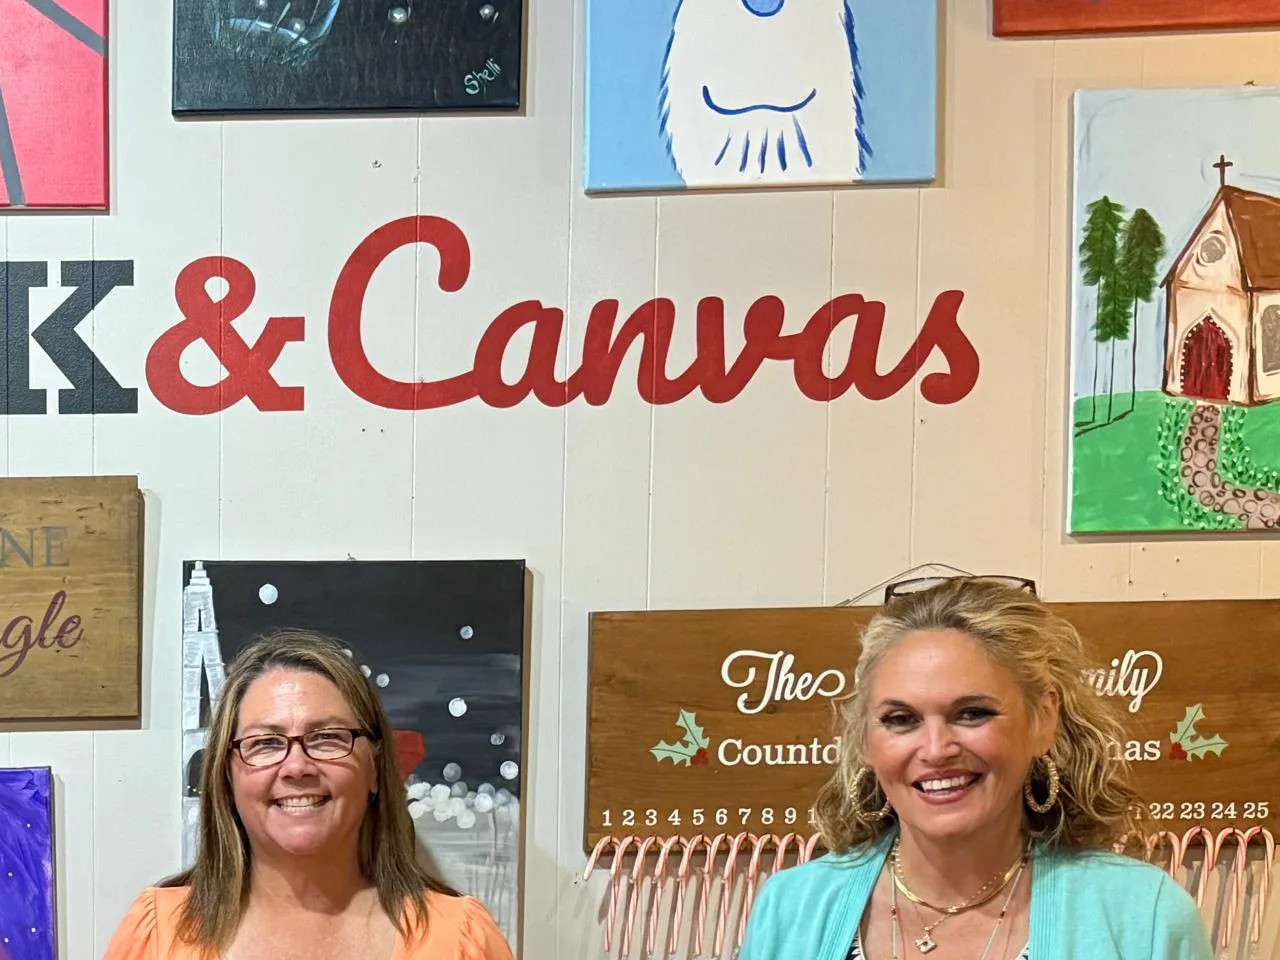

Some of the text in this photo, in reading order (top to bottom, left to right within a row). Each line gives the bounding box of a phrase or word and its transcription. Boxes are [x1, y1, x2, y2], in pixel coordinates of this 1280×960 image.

[463, 58, 502, 95] Shelli
[145, 255, 306, 416] &
[327, 214, 981, 411] Canvas
[721, 649, 846, 714] The
[602, 809, 612, 826] 1
[622, 809, 635, 826] 2
[645, 809, 658, 826] 3
[667, 808, 682, 826] 4
[692, 808, 705, 826] 5
[715, 808, 728, 825] 6
[738, 808, 752, 825] 7
[761, 807, 774, 825] 8
[784, 807, 797, 825] 9
[1149, 802, 1175, 819] 22
[1180, 802, 1206, 819] 23
[1211, 802, 1237, 819] 24
[1243, 801, 1269, 819] 25
